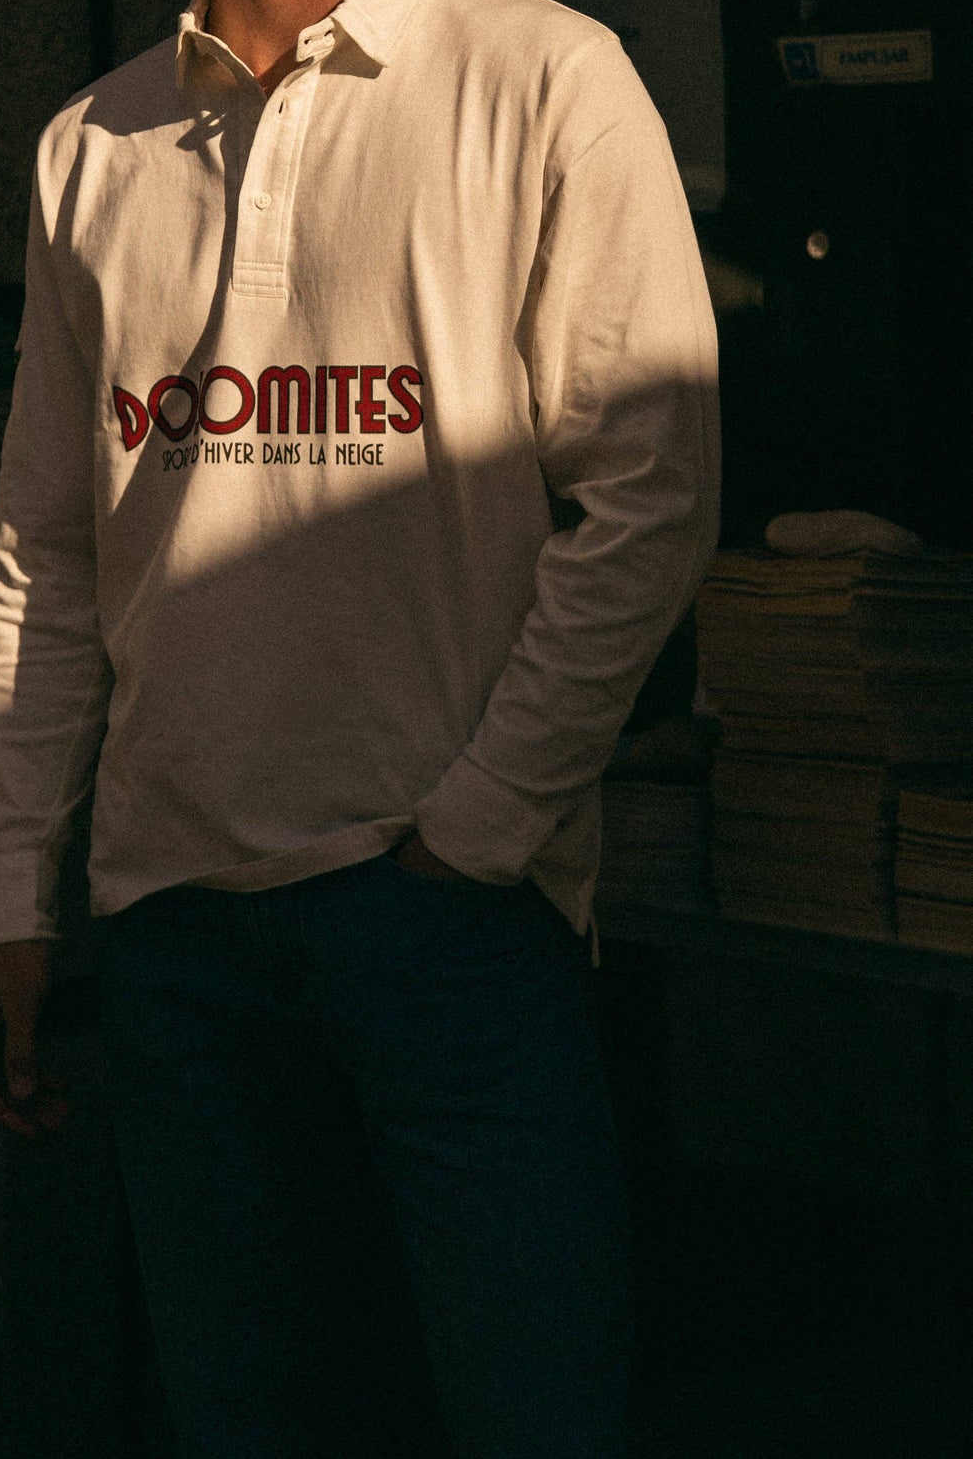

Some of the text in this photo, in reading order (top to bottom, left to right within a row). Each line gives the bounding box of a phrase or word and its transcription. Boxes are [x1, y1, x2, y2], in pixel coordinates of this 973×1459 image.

[112, 365, 425, 452] DOOMITES
[263, 443, 301, 465] DANS
[309, 443, 327, 465] LA
[335, 443, 384, 466] NEIGE
